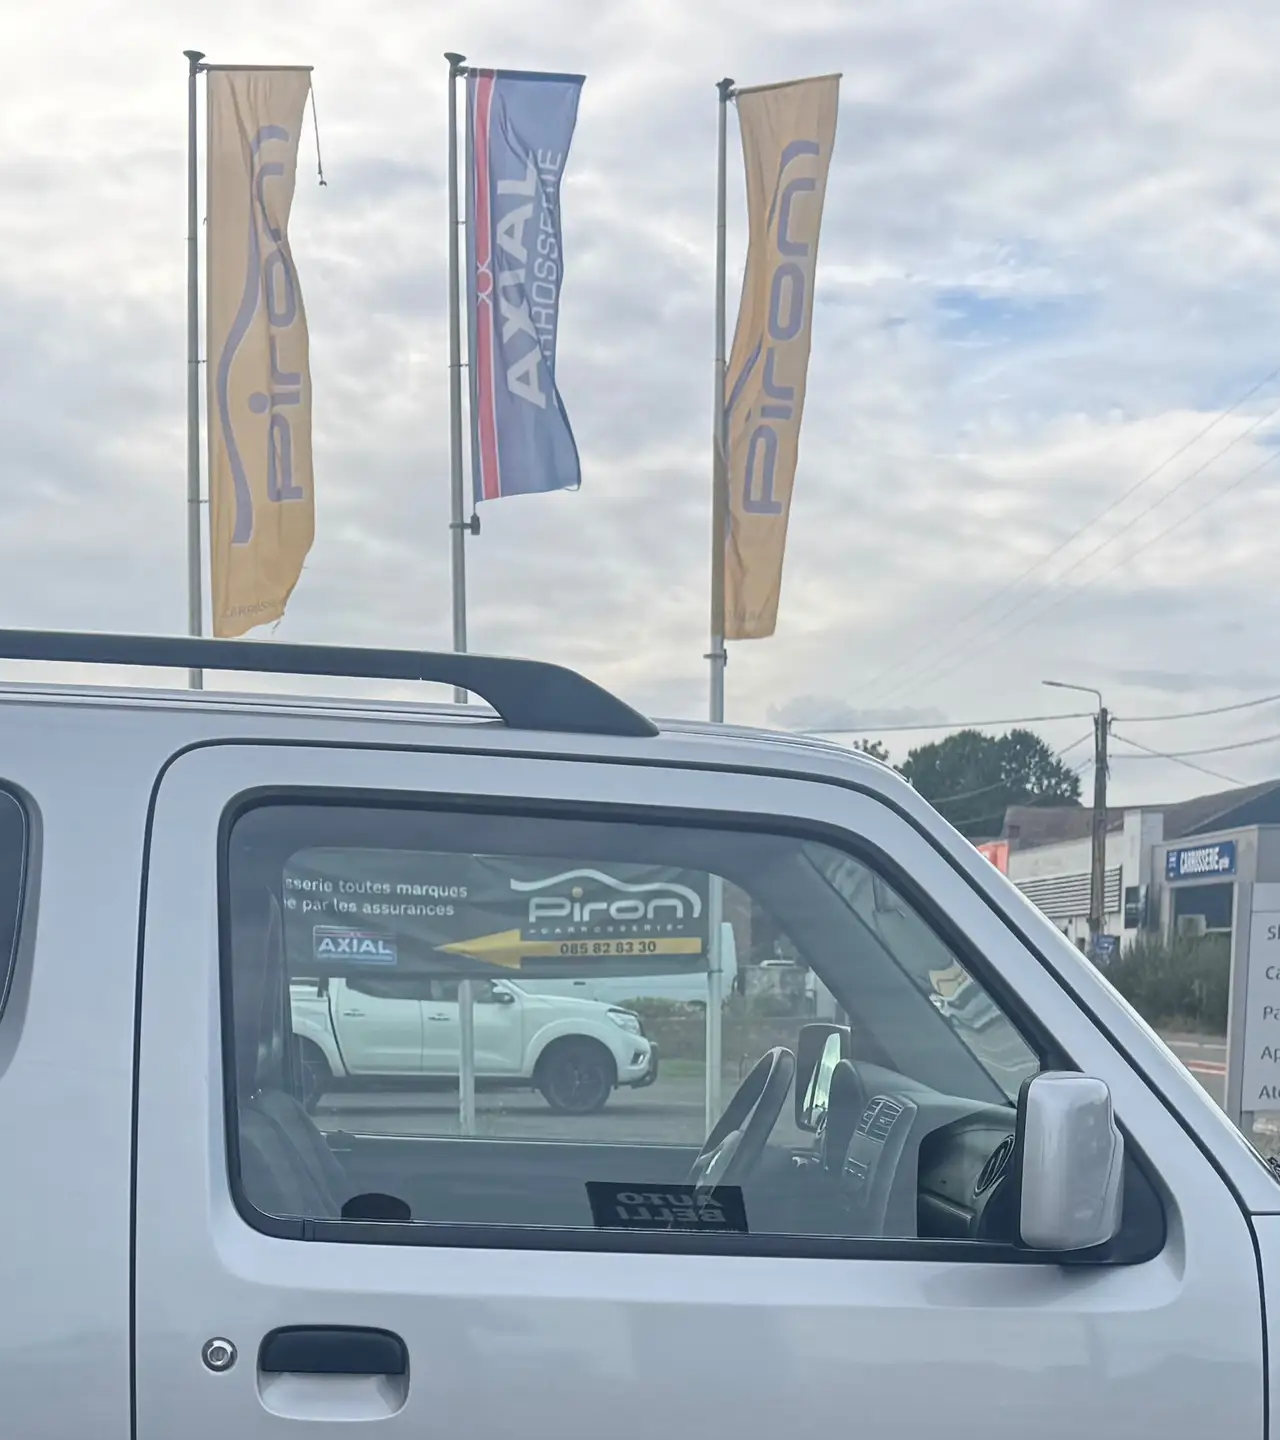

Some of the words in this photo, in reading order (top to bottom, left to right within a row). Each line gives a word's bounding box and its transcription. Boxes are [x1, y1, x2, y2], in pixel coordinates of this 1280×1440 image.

[497, 154, 546, 409] AXIAL
[339, 879, 391, 895] toutes
[396, 882, 468, 899] marques
[303, 899, 329, 914] par
[334, 898, 357, 914] les
[362, 902, 455, 916] assurances
[318, 937, 393, 954] AXIAL
[638, 940, 657, 953] 30
